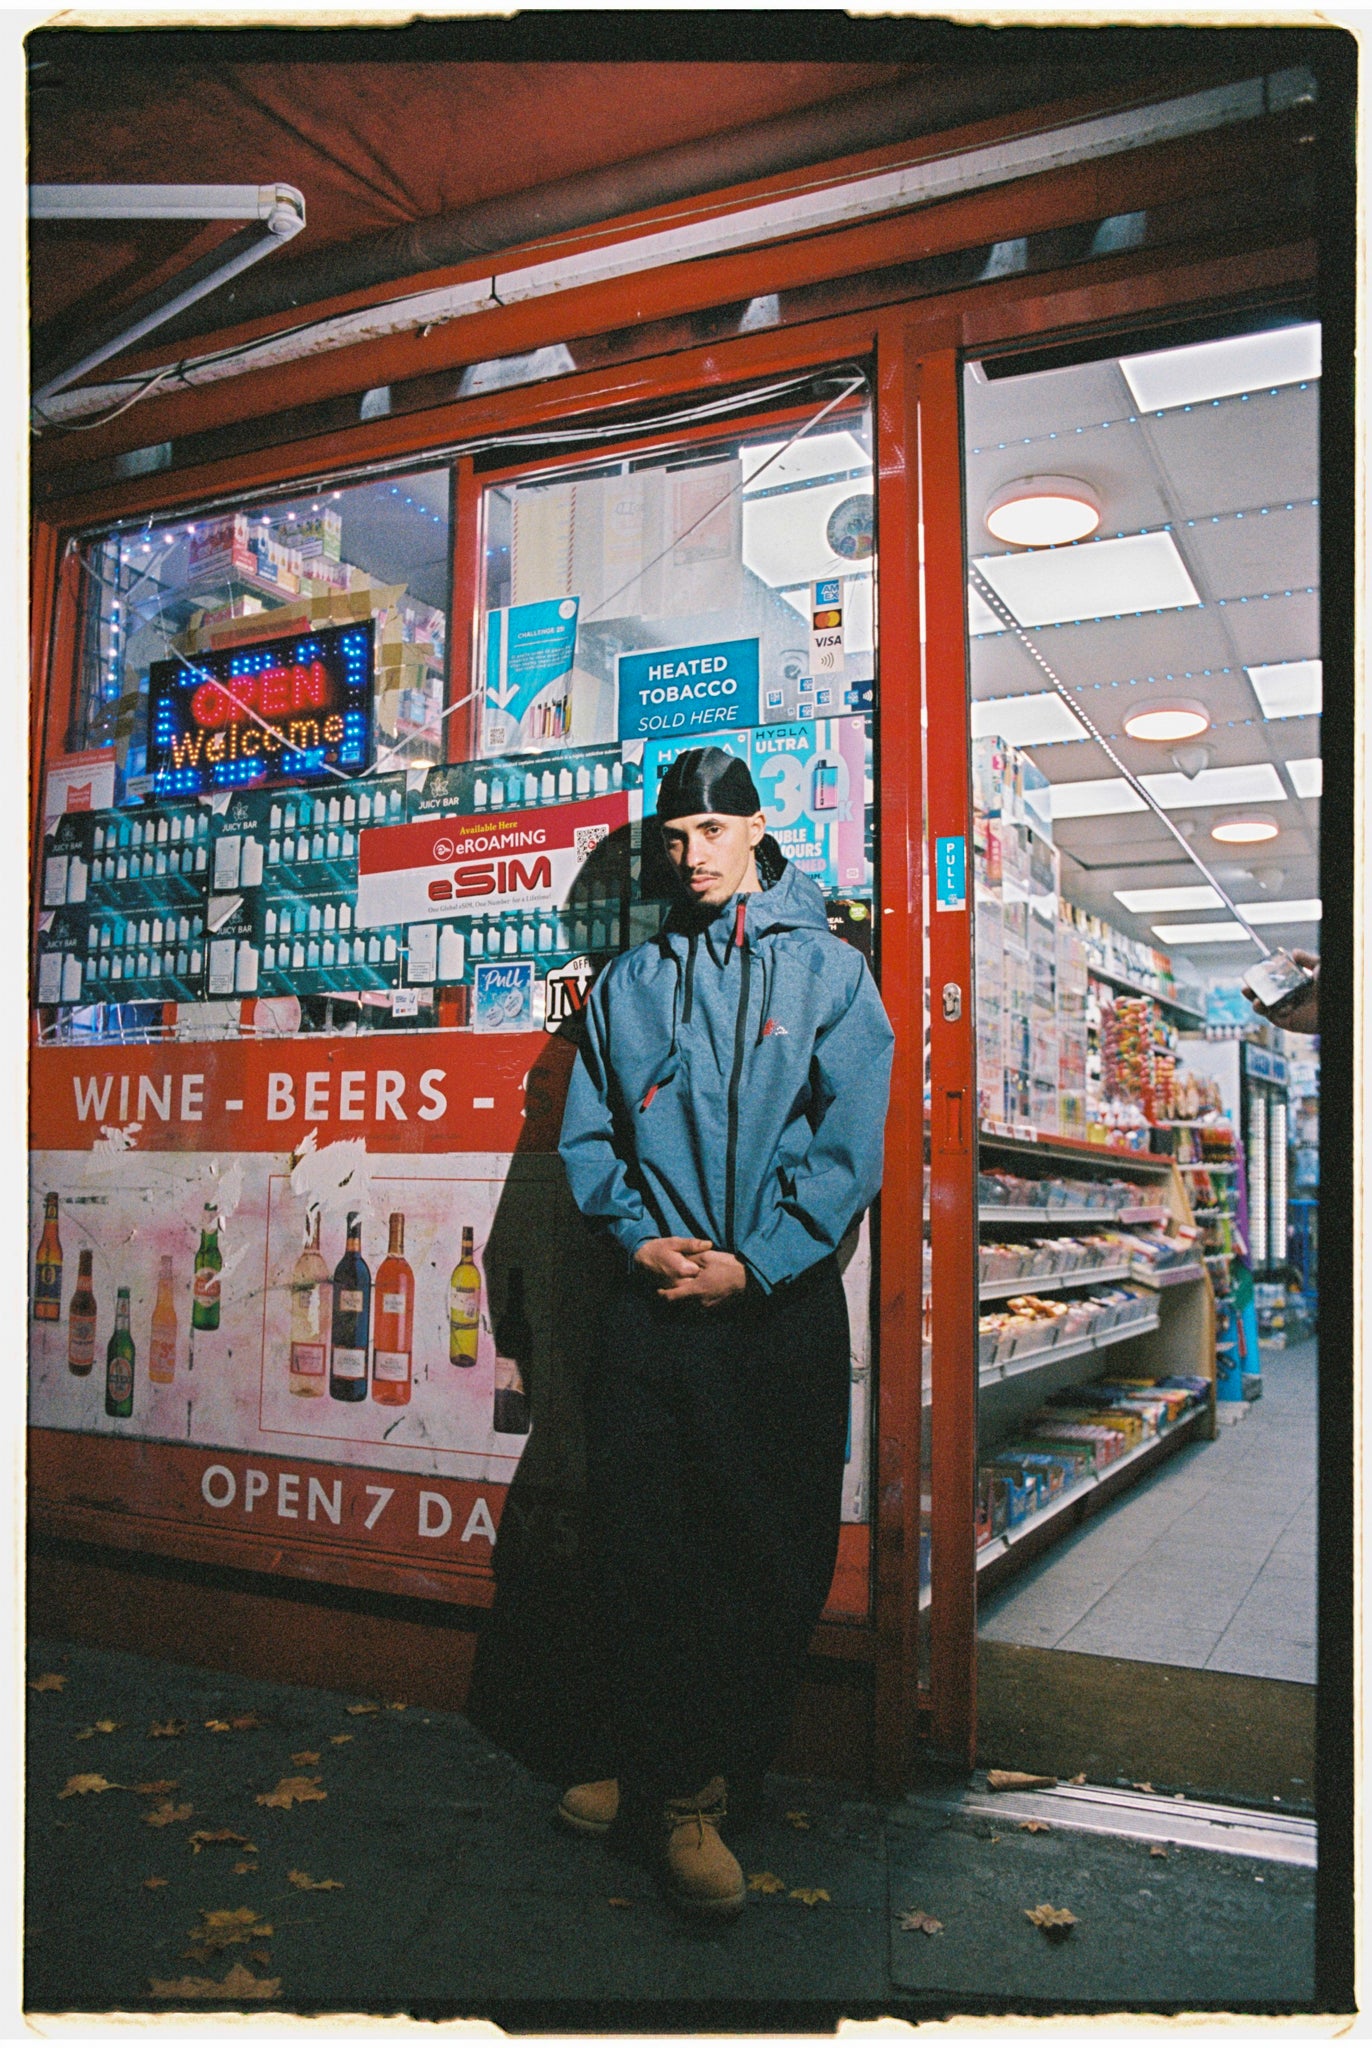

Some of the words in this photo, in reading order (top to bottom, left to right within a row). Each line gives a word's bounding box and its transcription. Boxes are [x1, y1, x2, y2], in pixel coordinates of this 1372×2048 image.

[815, 635, 842, 648] VISA
[648, 656, 728, 680] HEATED
[190, 664, 327, 725] OPEN
[639, 679, 738, 706] TOBACCO
[638, 709, 687, 732] SOLD
[690, 706, 739, 727] HERE
[171, 714, 344, 769] Welcome
[756, 726, 808, 740] HYOLA
[756, 737, 809, 754] ULTRA
[418, 799, 441, 810] JUICY
[443, 796, 460, 807] BAR
[222, 822, 241, 832] JUICY
[243, 820, 258, 829] BAR
[459, 822, 496, 835] Available
[498, 820, 518, 831] Here
[70, 841, 83, 849] BAR
[456, 829, 547, 855] eROAMING
[946, 843, 956, 889] PULL
[428, 855, 552, 902] eSIM
[237, 925, 253, 934] BAR
[64, 938, 77, 946] BAR
[484, 967, 523, 992] Pull
[73, 1073, 205, 1122] WINE
[267, 1069, 447, 1122] BEERS
[201, 1464, 343, 1525] OPEN
[364, 1486, 395, 1530] 7
